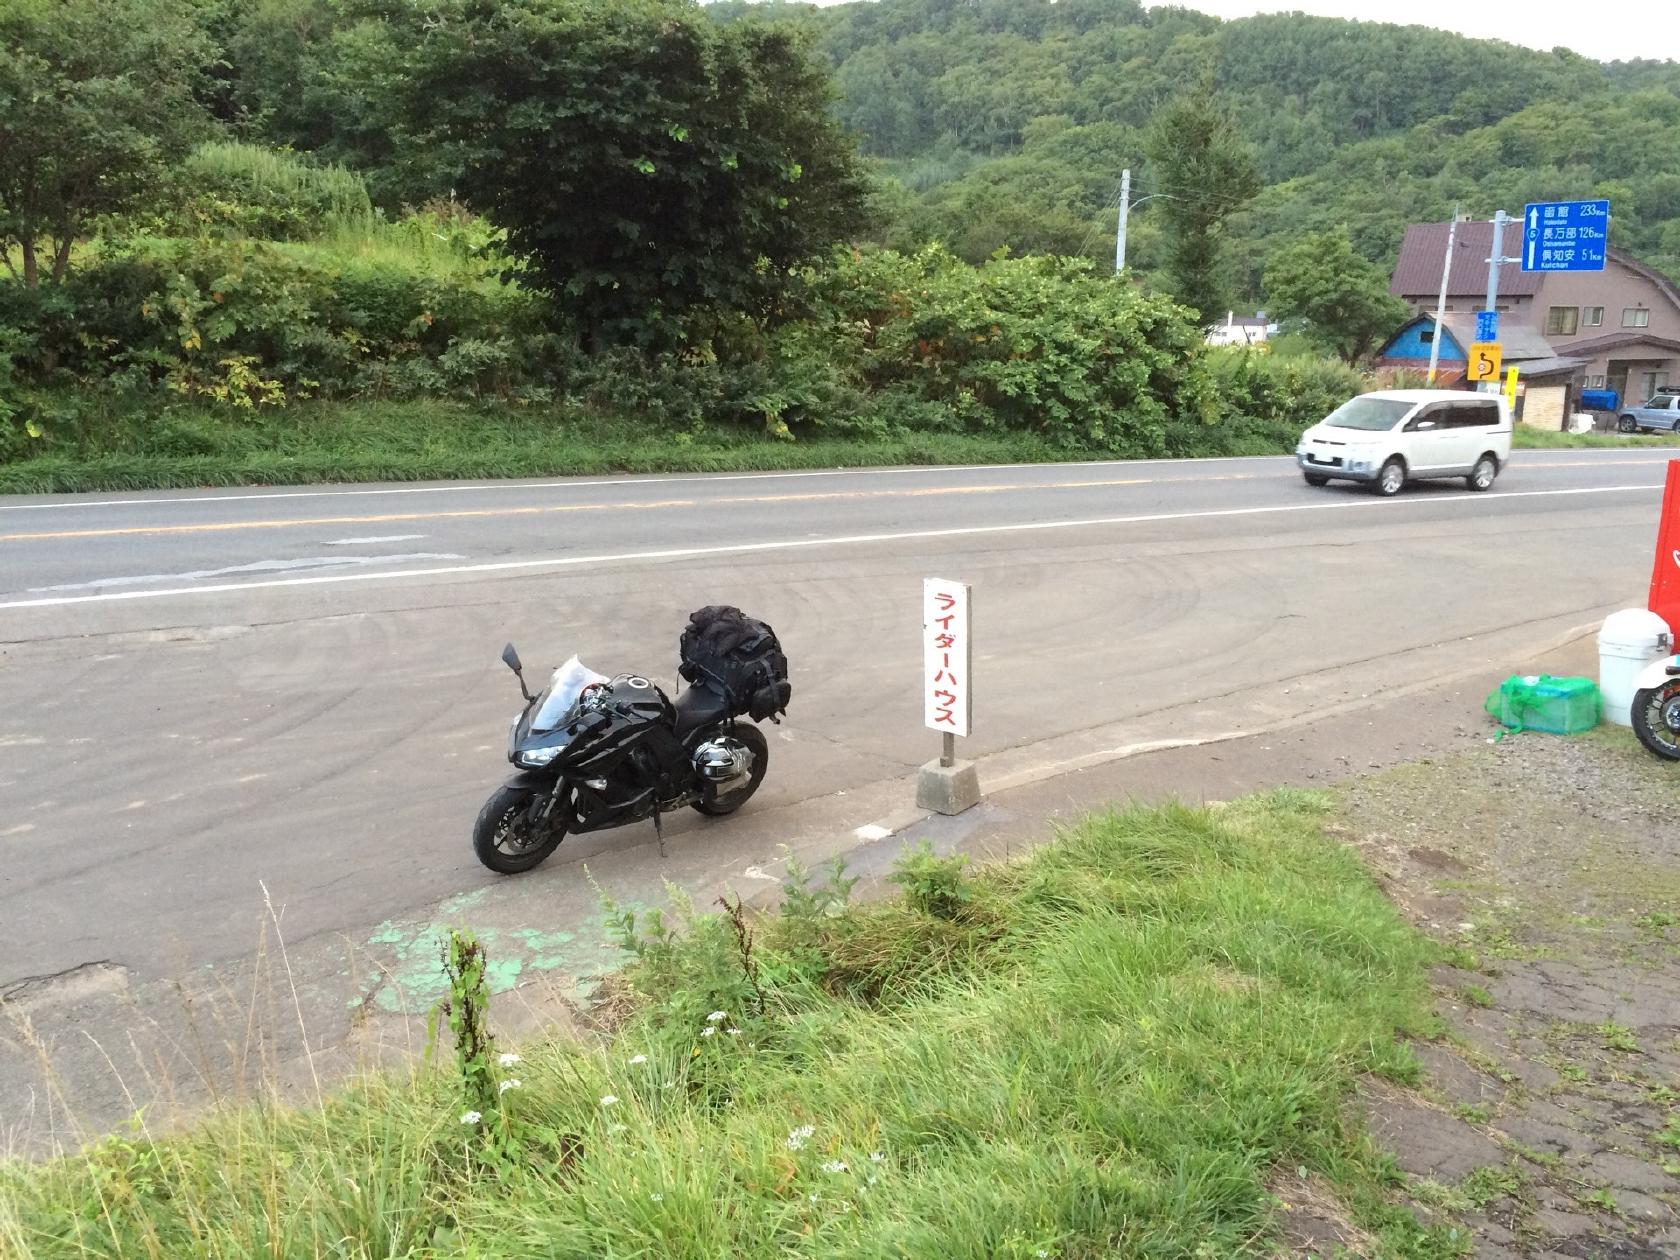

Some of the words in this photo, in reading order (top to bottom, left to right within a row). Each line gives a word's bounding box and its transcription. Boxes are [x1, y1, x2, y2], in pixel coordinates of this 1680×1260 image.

[1544, 206, 1569, 218] 函館
[1530, 230, 1536, 238] 5
[1543, 227, 1577, 240] 長万部
[934, 592, 957, 726] ライダーハウス
